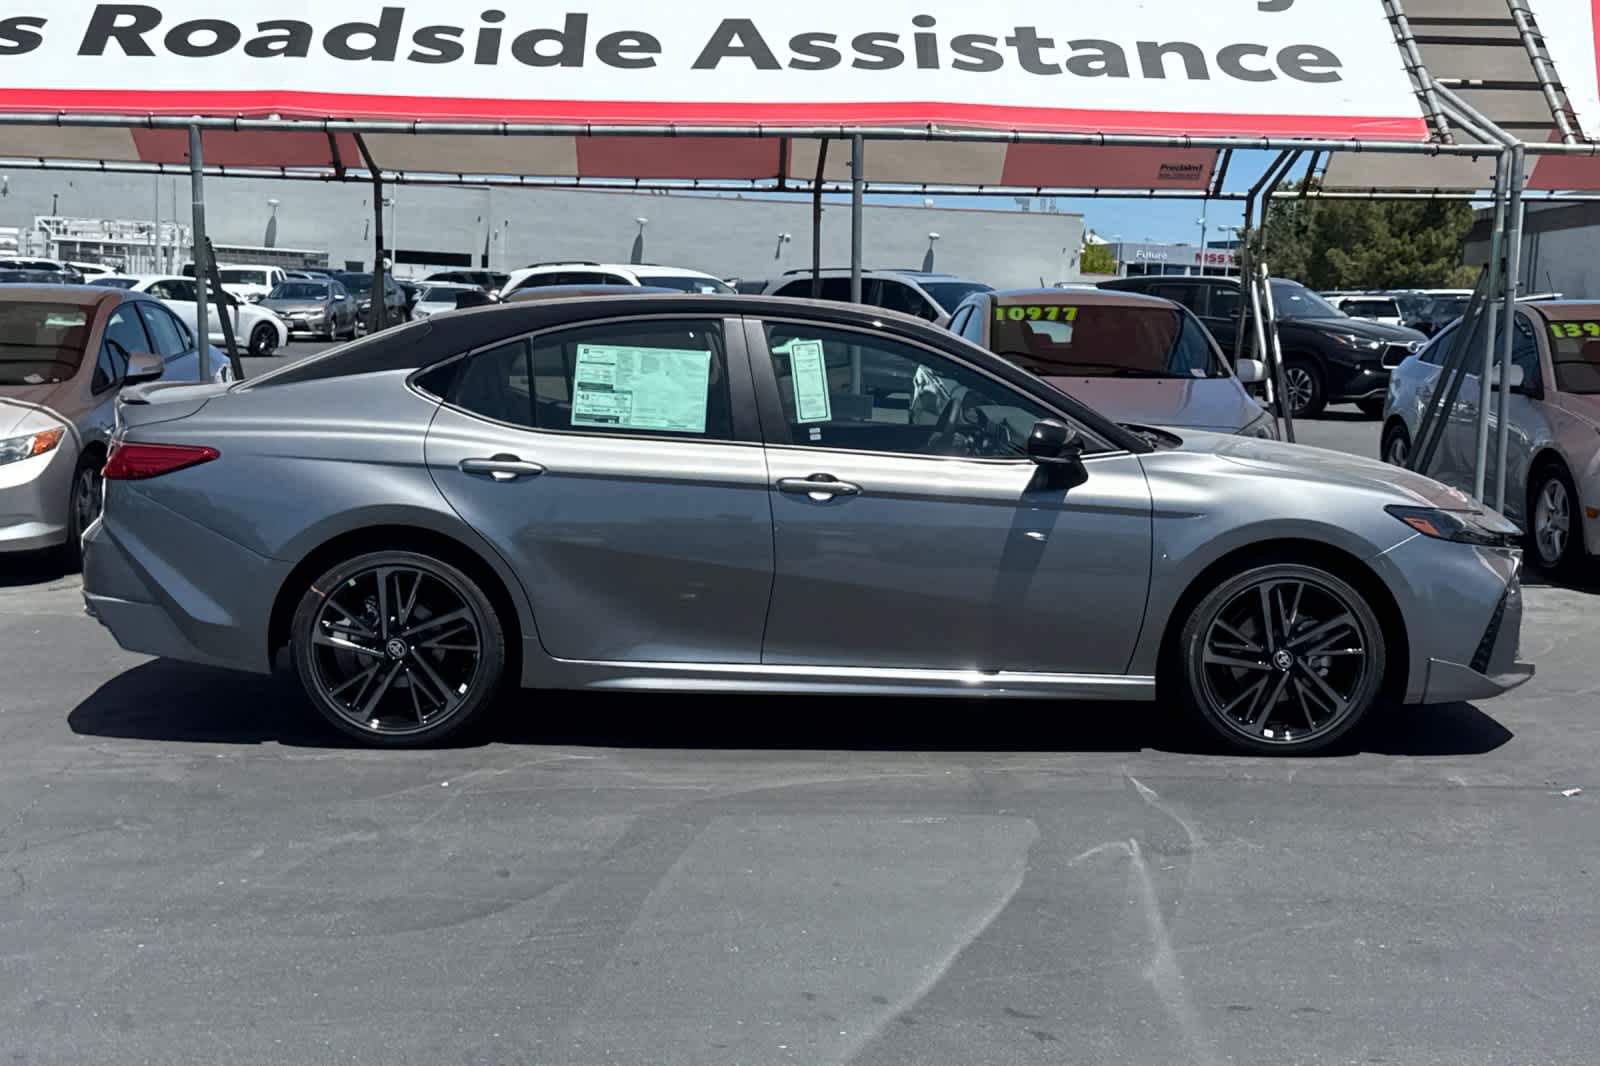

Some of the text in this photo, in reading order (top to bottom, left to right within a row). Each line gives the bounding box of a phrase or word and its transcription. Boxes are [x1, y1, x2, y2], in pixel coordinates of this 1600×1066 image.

[77, 4, 661, 68] Roadside
[691, 8, 1342, 83] Assistance
[995, 306, 1077, 321] 10977
